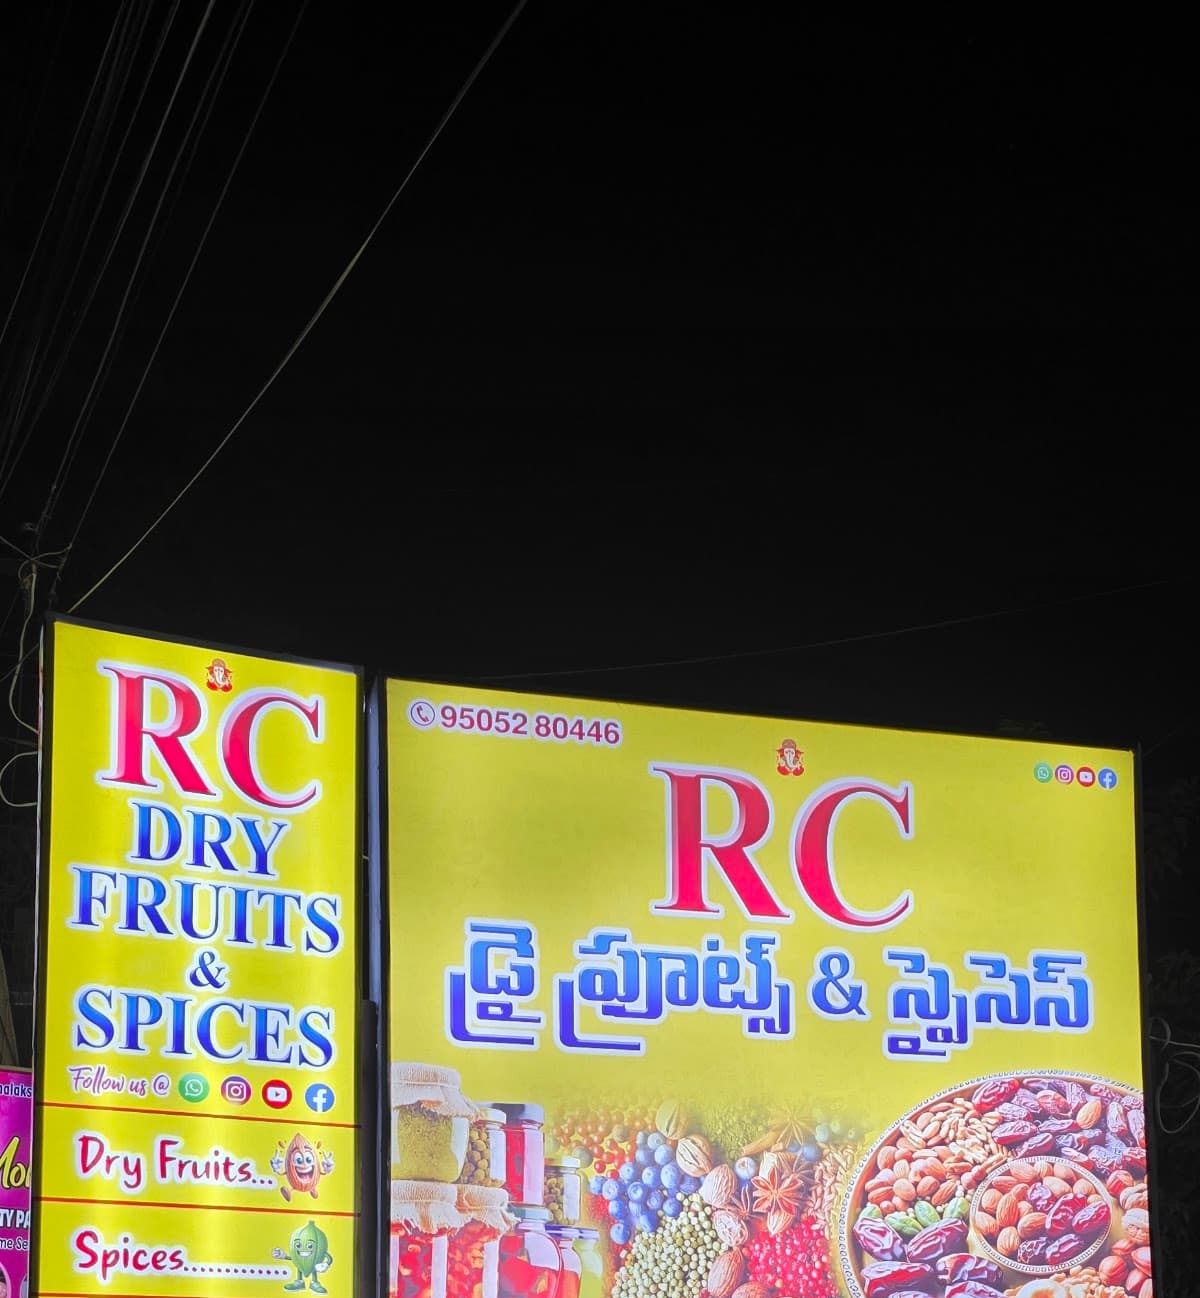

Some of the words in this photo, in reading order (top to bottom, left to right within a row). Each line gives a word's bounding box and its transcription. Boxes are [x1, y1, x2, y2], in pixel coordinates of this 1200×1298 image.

[101, 665, 321, 809] RC
[440, 705, 528, 735] 95052
[534, 715, 620, 744] 80446
[131, 802, 288, 876] DRY
[651, 764, 912, 926] RC
[71, 866, 341, 954] FRUITS
[190, 951, 226, 989] &
[450, 922, 541, 1045] డ్రై
[811, 951, 866, 1016] &
[887, 950, 1090, 1056] స్పైసెస్
[77, 989, 333, 1067] SPICES
[69, 1066, 124, 1094] Follow
[129, 1079, 147, 1096] us
[153, 1074, 170, 1096] @
[78, 1135, 142, 1188] Dry
